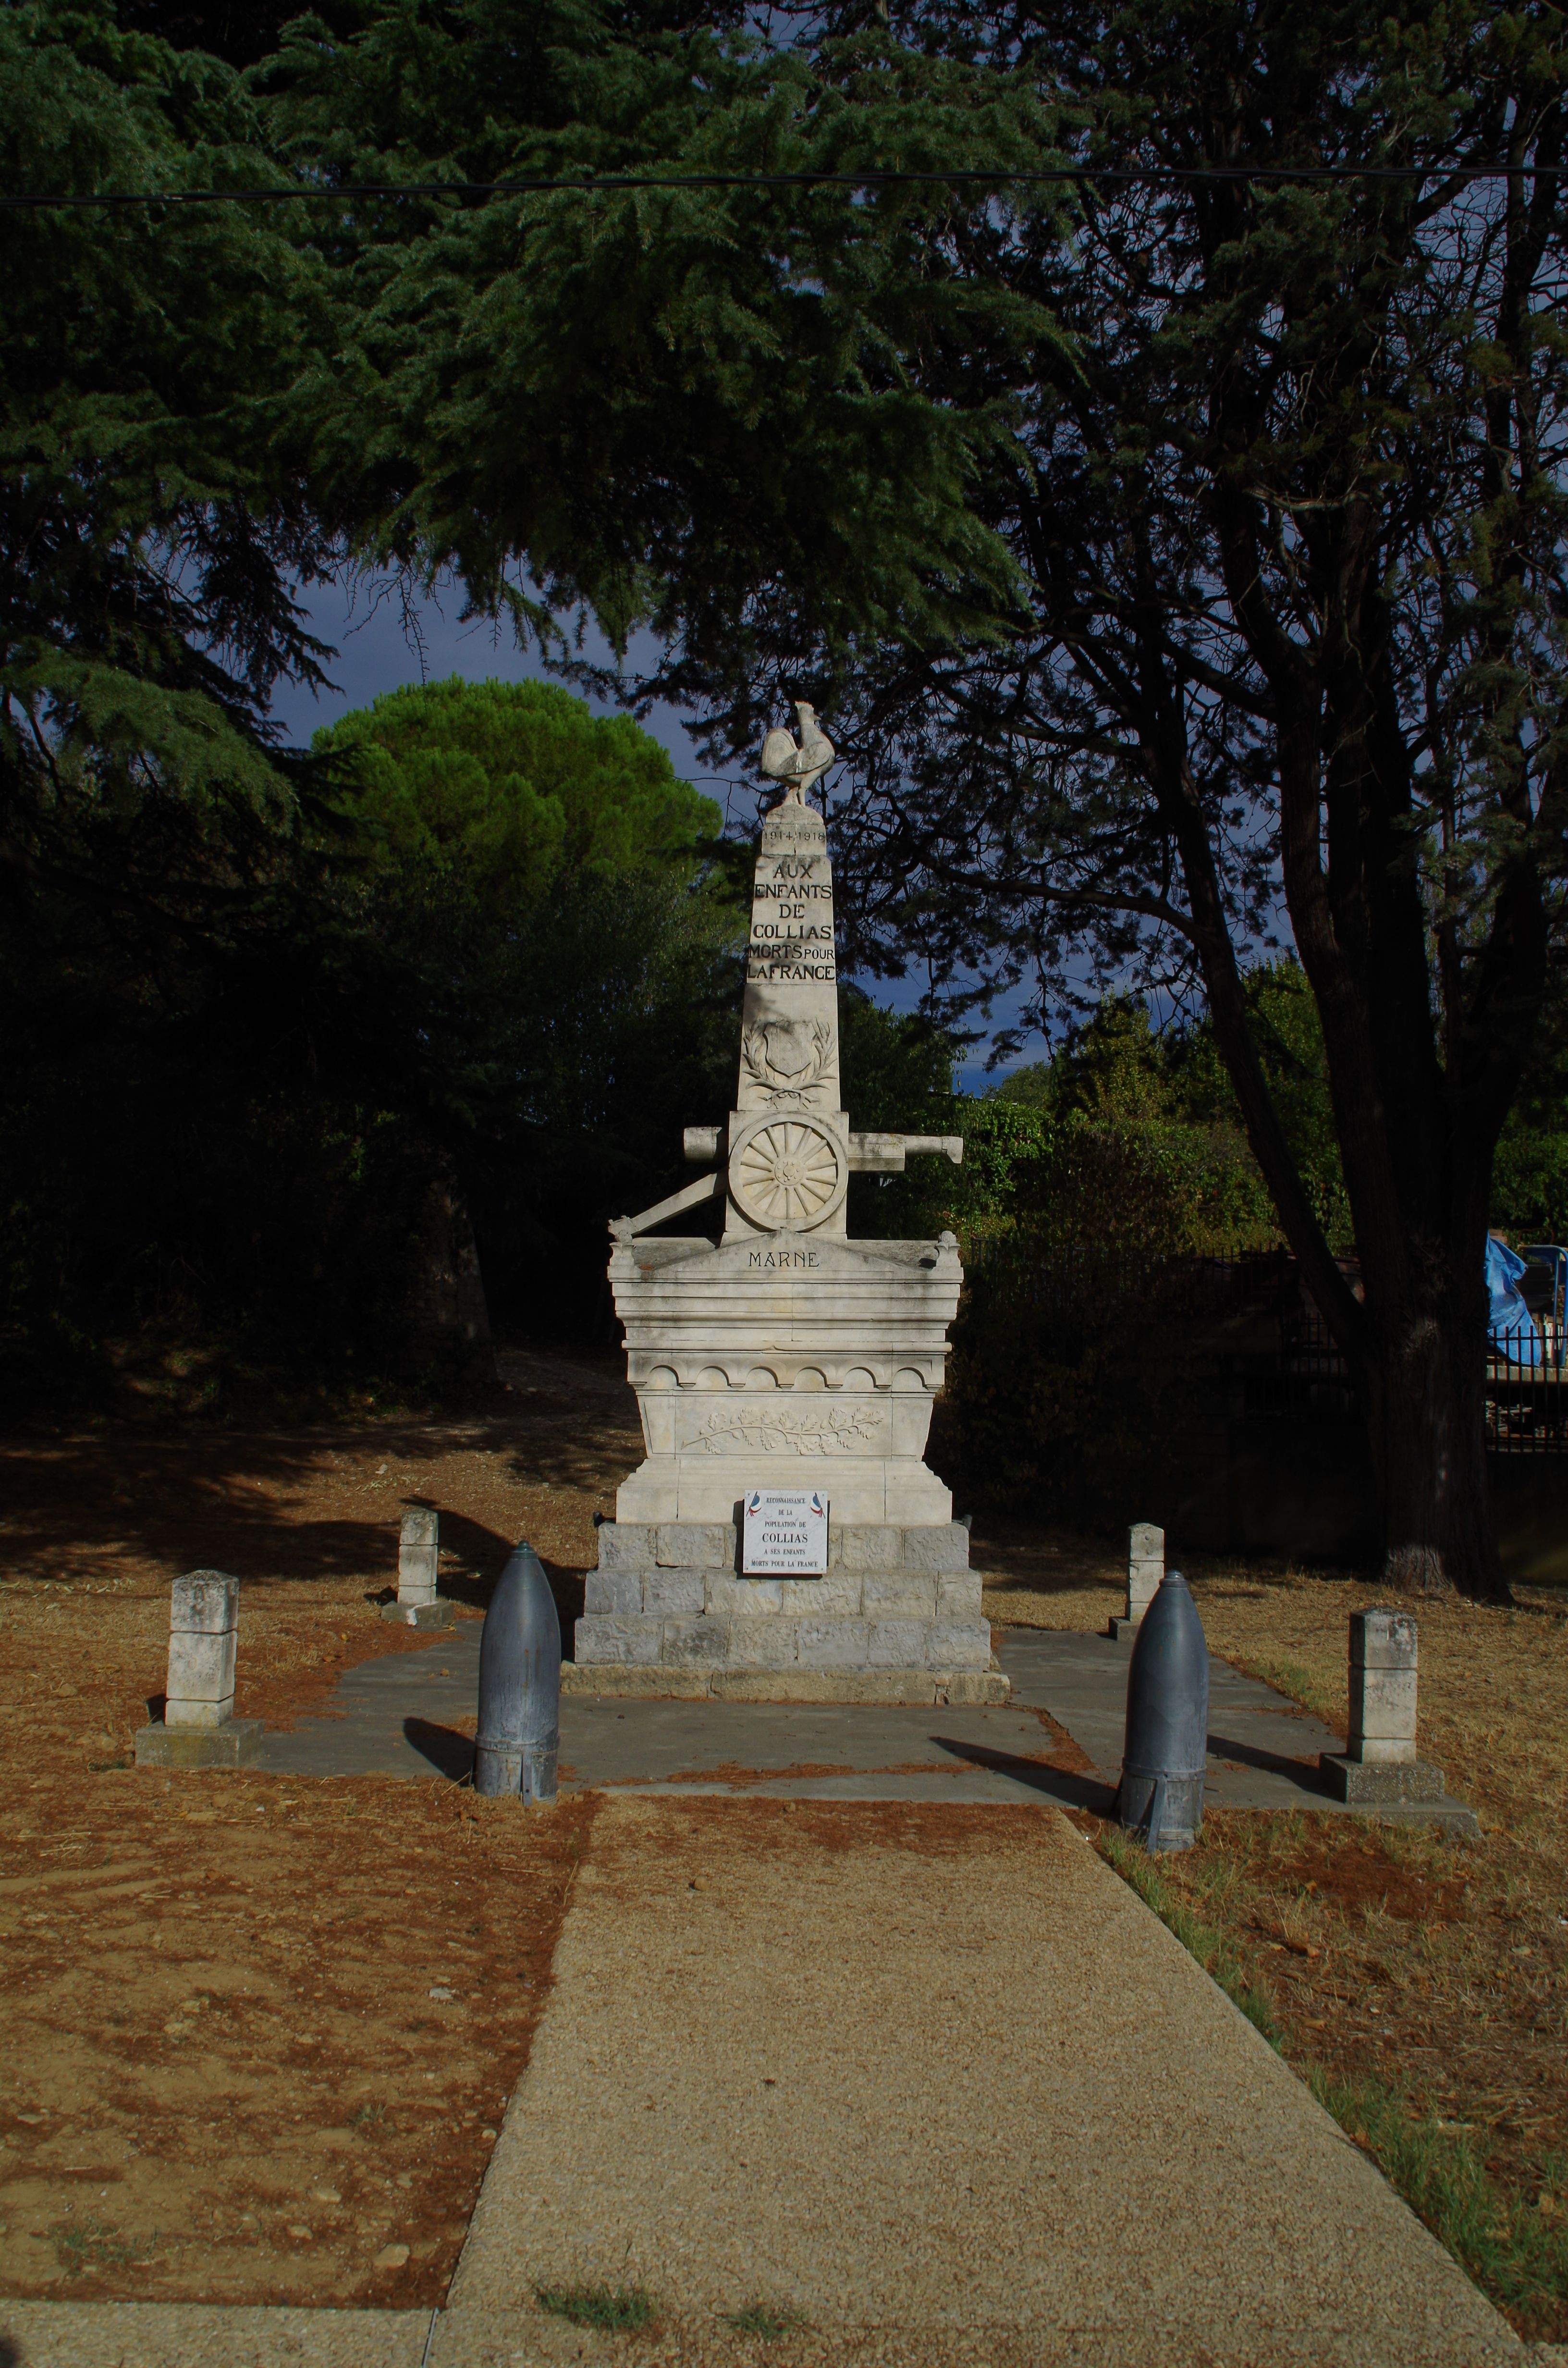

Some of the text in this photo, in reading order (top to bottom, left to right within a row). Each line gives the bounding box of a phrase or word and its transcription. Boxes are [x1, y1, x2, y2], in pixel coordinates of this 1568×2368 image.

[764, 832, 824, 840] 1914 1918
[773, 864, 812, 878] AUX
[755, 884, 832, 899] ENFANTS
[780, 904, 804, 919] DE
[753, 925, 831, 939] COLLIAS
[748, 944, 834, 960] MORTS POUR
[748, 1252, 819, 1267] MARNE
[762, 1533, 808, 1543] COLLIAS
